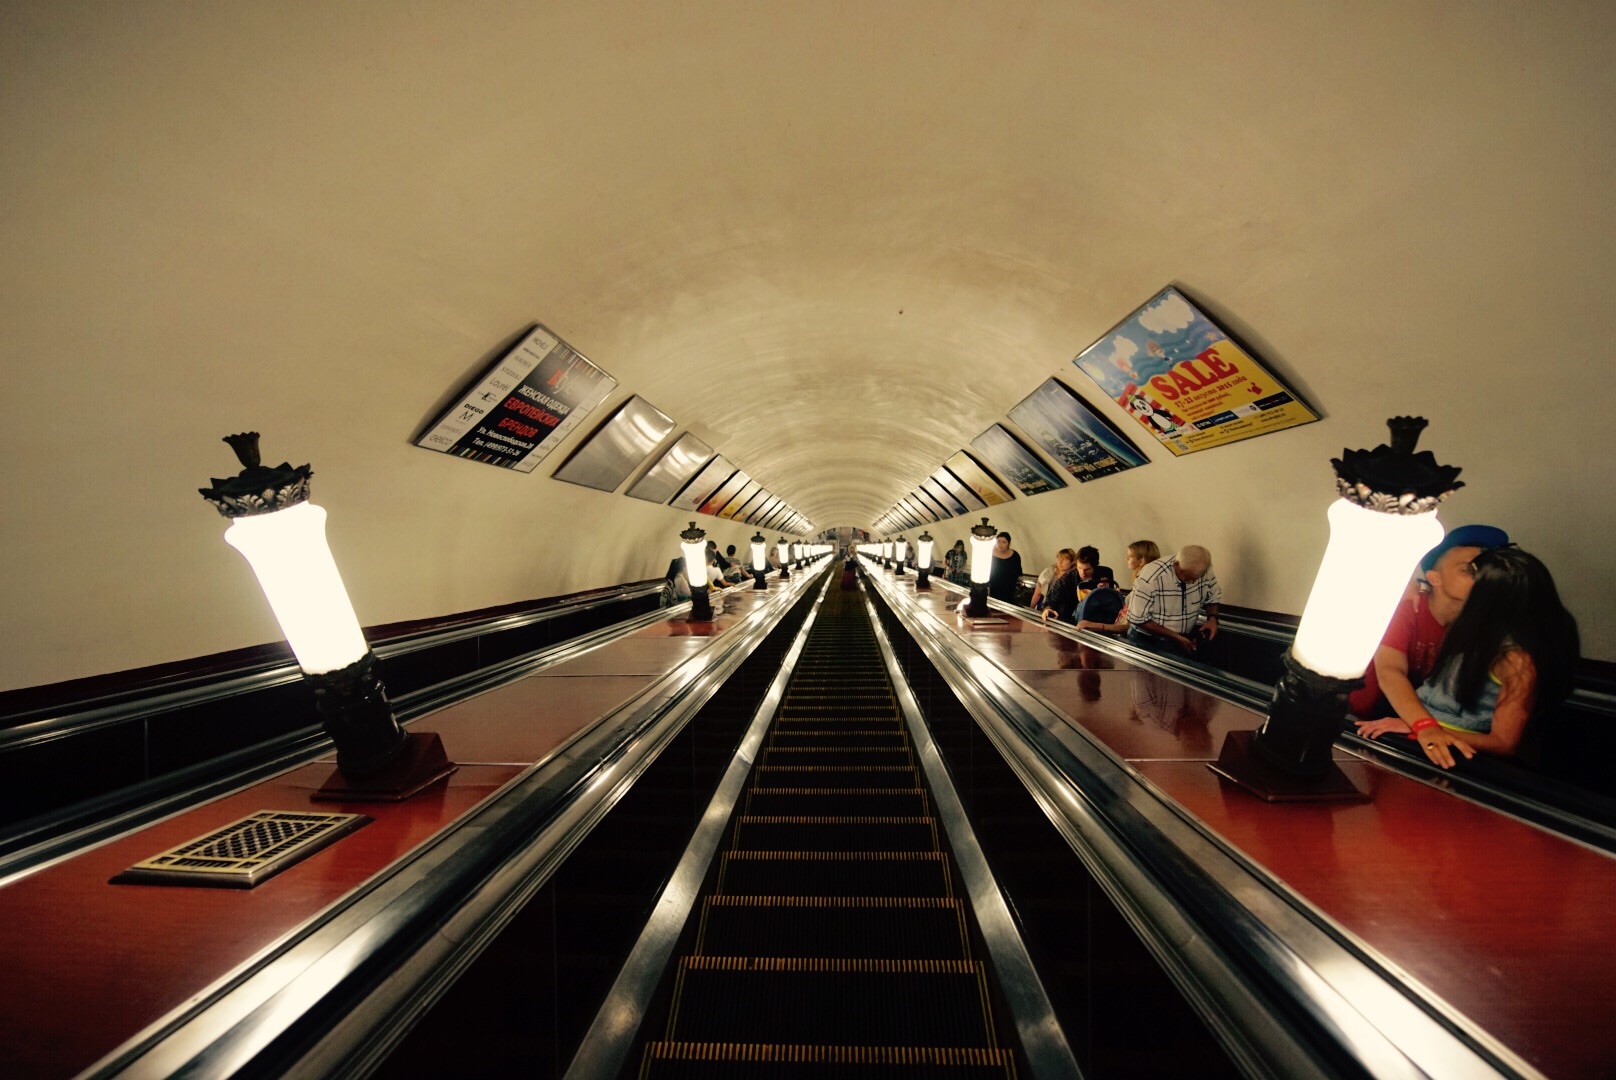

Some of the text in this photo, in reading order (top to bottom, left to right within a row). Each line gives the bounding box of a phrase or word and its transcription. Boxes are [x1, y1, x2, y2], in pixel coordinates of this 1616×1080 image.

[1150, 347, 1239, 400] SALE
[1216, 382, 1233, 393] 2015
[1231, 375, 1248, 386] года
[464, 403, 485, 415] DIEGO
[518, 384, 548, 405] ЖЕНСКАЯ
[545, 398, 571, 415] ОДЕЖДА
[459, 410, 475, 422] M
[503, 397, 561, 427] ЕВРОПЕЙСКИХ
[498, 417, 539, 438] БРЕНДОВ
